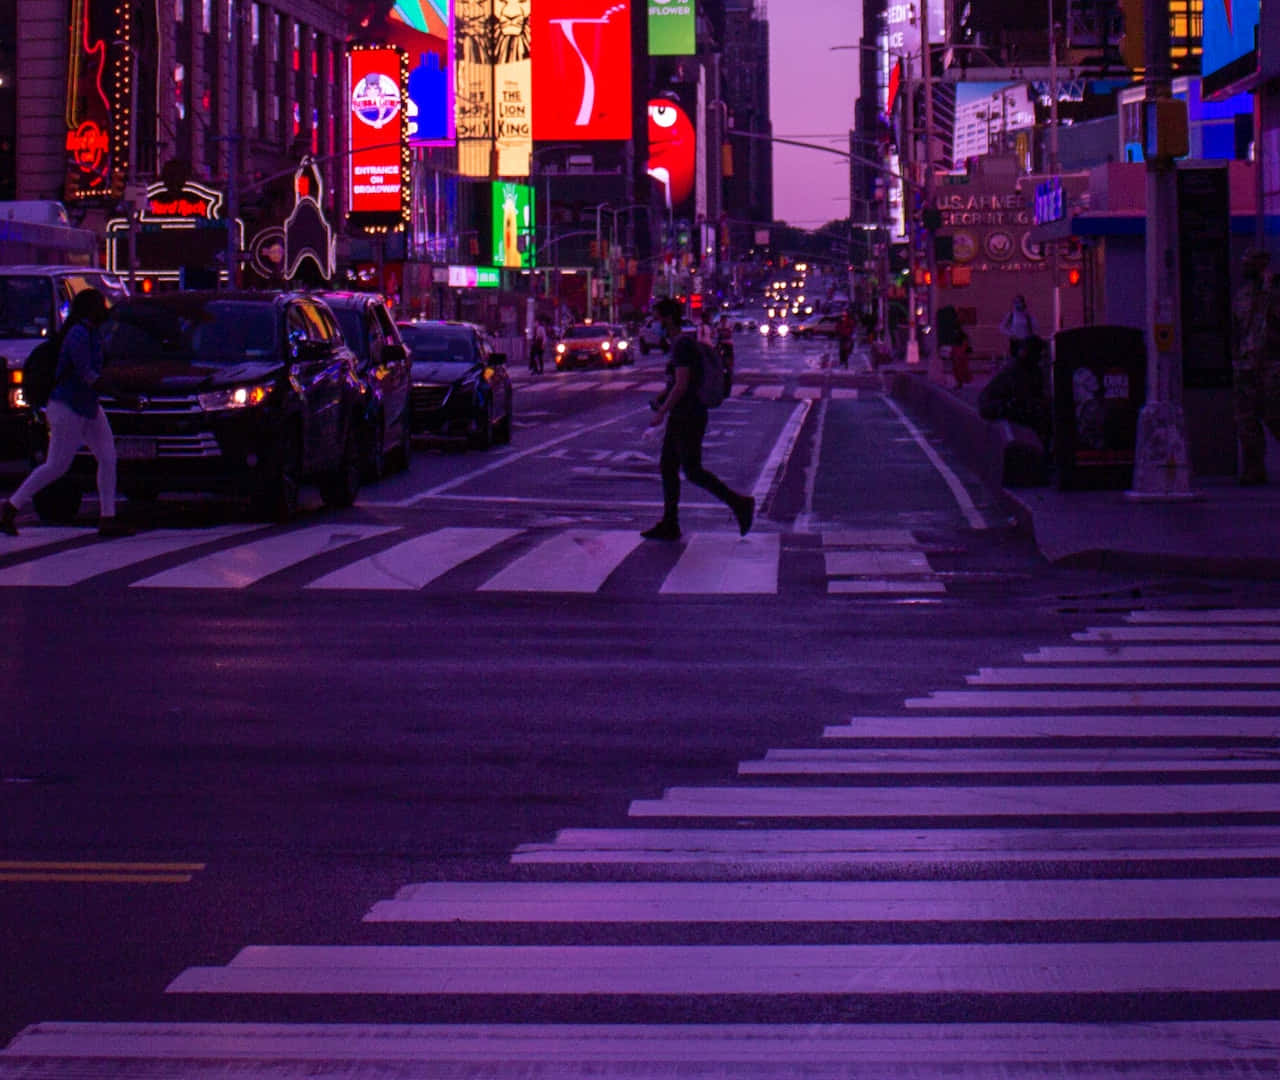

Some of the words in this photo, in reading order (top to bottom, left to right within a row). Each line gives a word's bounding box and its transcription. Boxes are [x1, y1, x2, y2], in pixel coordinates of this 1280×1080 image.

[503, 90, 521, 102] THE
[499, 102, 525, 118] LION
[498, 119, 529, 138] KING
